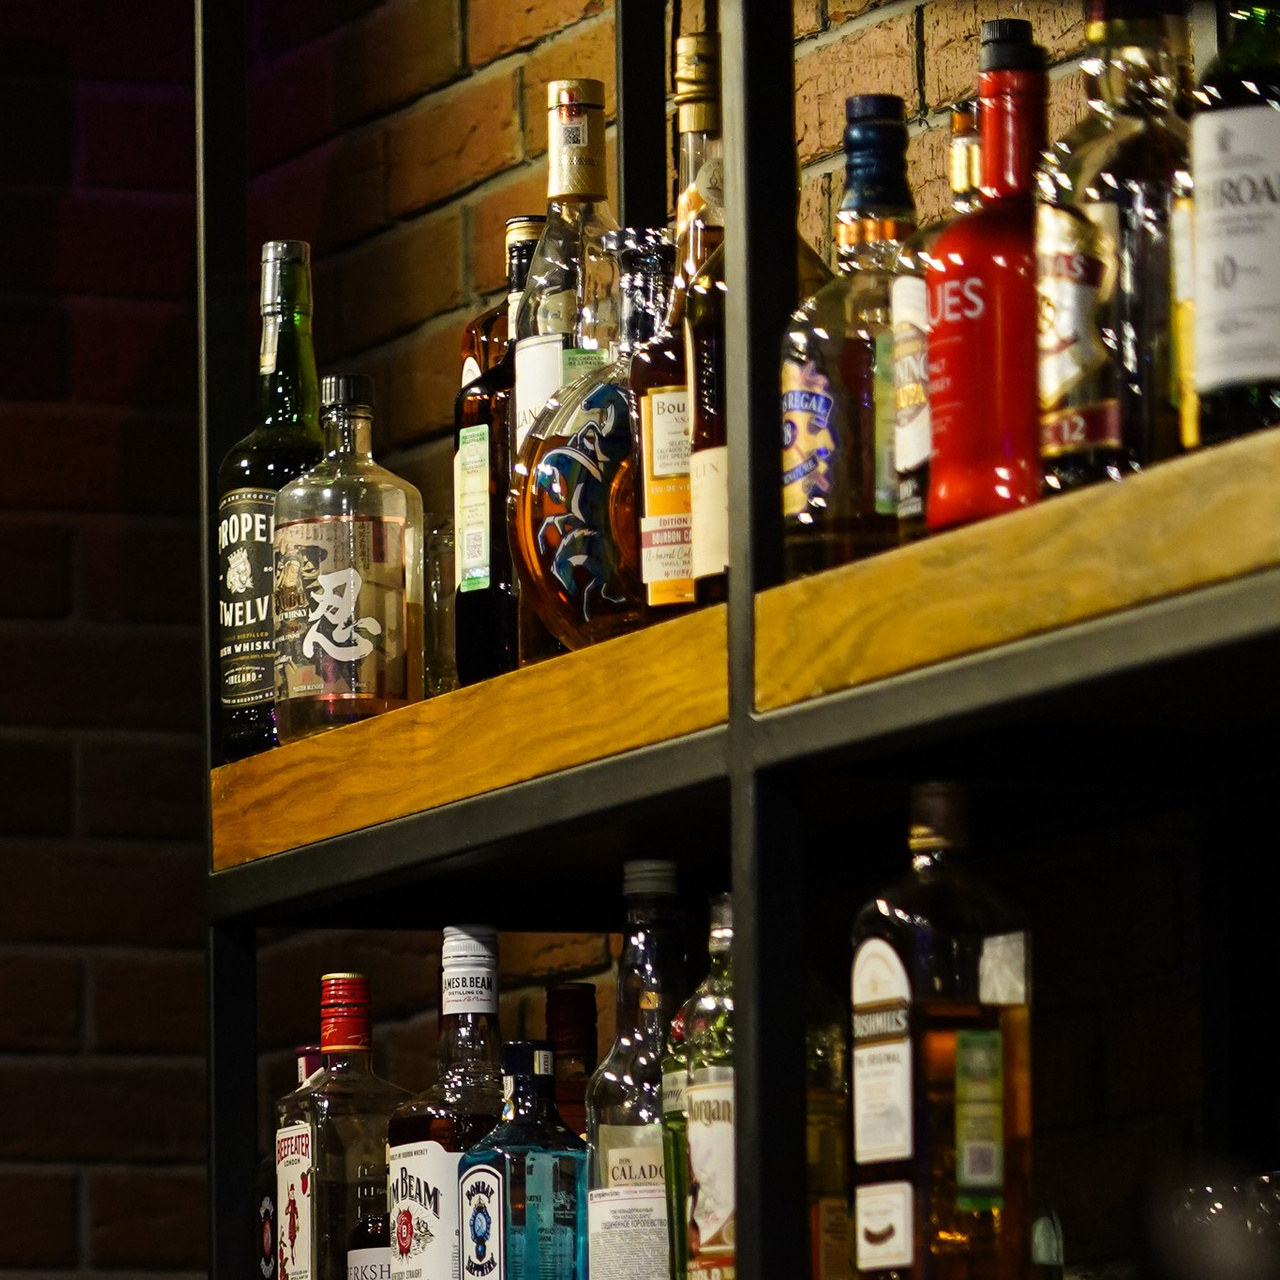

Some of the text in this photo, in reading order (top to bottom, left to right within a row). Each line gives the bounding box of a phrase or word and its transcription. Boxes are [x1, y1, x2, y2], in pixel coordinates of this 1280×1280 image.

[1061, 415, 1086, 442] 12
[652, 530, 681, 545] BOURBON
[303, 568, 381, 662] 忍
[277, 1133, 310, 1175] BEEFEATER
[284, 1158, 301, 1167] LONDON
[401, 1167, 440, 1220] BEAM
[465, 1181, 495, 1206] BOMBAY
